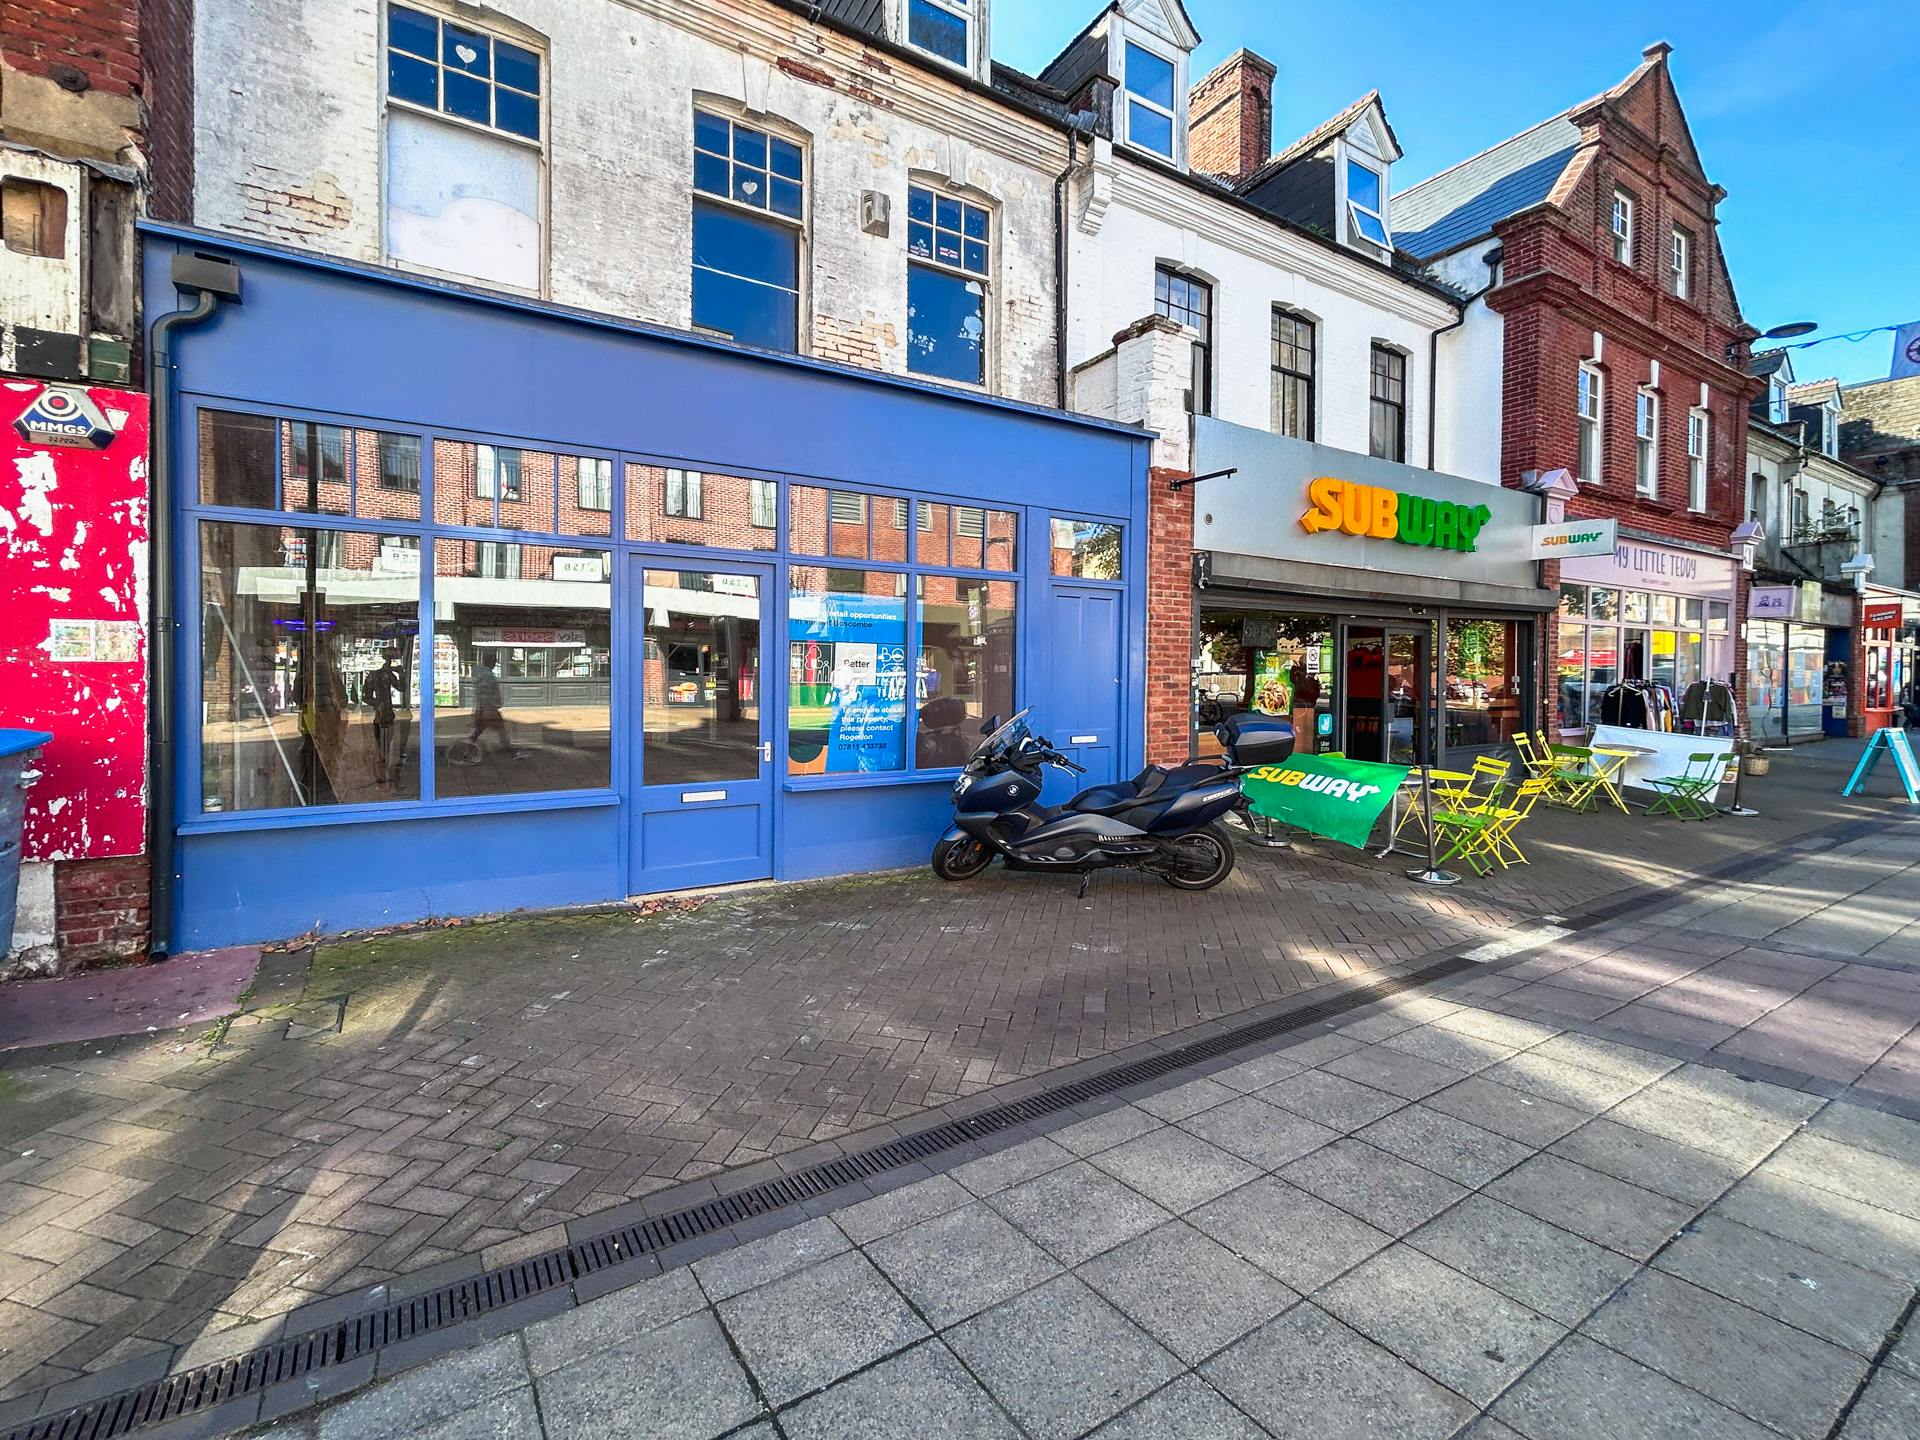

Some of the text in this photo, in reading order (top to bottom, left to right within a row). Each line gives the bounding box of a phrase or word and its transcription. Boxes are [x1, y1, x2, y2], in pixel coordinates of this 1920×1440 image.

[30, 421, 86, 435] MMGS
[1299, 477, 1492, 553] SUBWAY
[1540, 531, 1604, 547] SUBWAY
[1633, 548, 1666, 575] LITTLE
[1670, 555, 1697, 579] TEDDY
[850, 611, 897, 621] opportunities
[839, 733, 873, 742] Rogeron
[1246, 766, 1381, 803] SUBWAY
